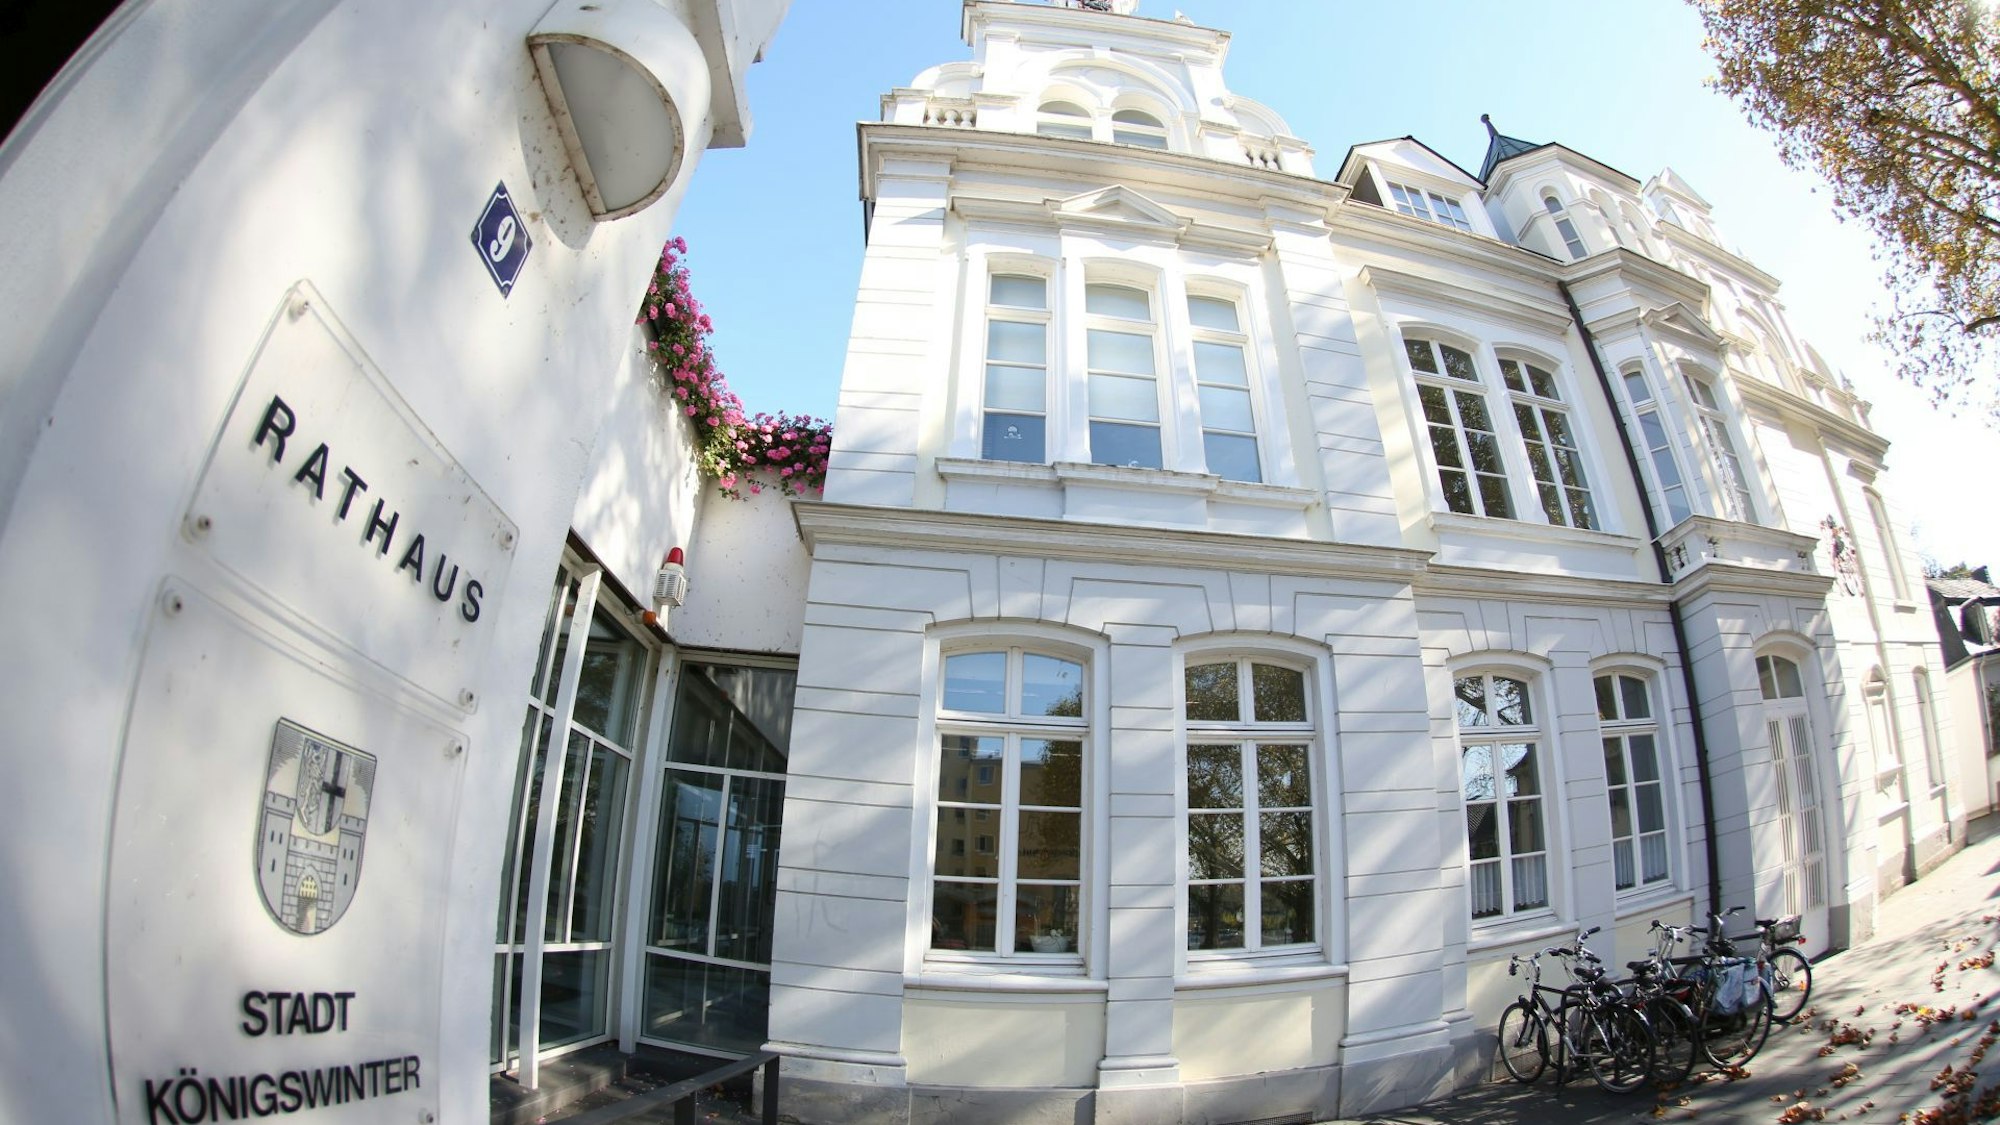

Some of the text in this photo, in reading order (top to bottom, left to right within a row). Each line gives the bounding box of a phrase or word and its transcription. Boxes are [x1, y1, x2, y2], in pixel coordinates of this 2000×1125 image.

[490, 215, 516, 262] 9
[254, 394, 484, 623] RATHAUS
[242, 990, 356, 1037] STADT
[144, 1055, 421, 1125] KÖNIGSWINTER
